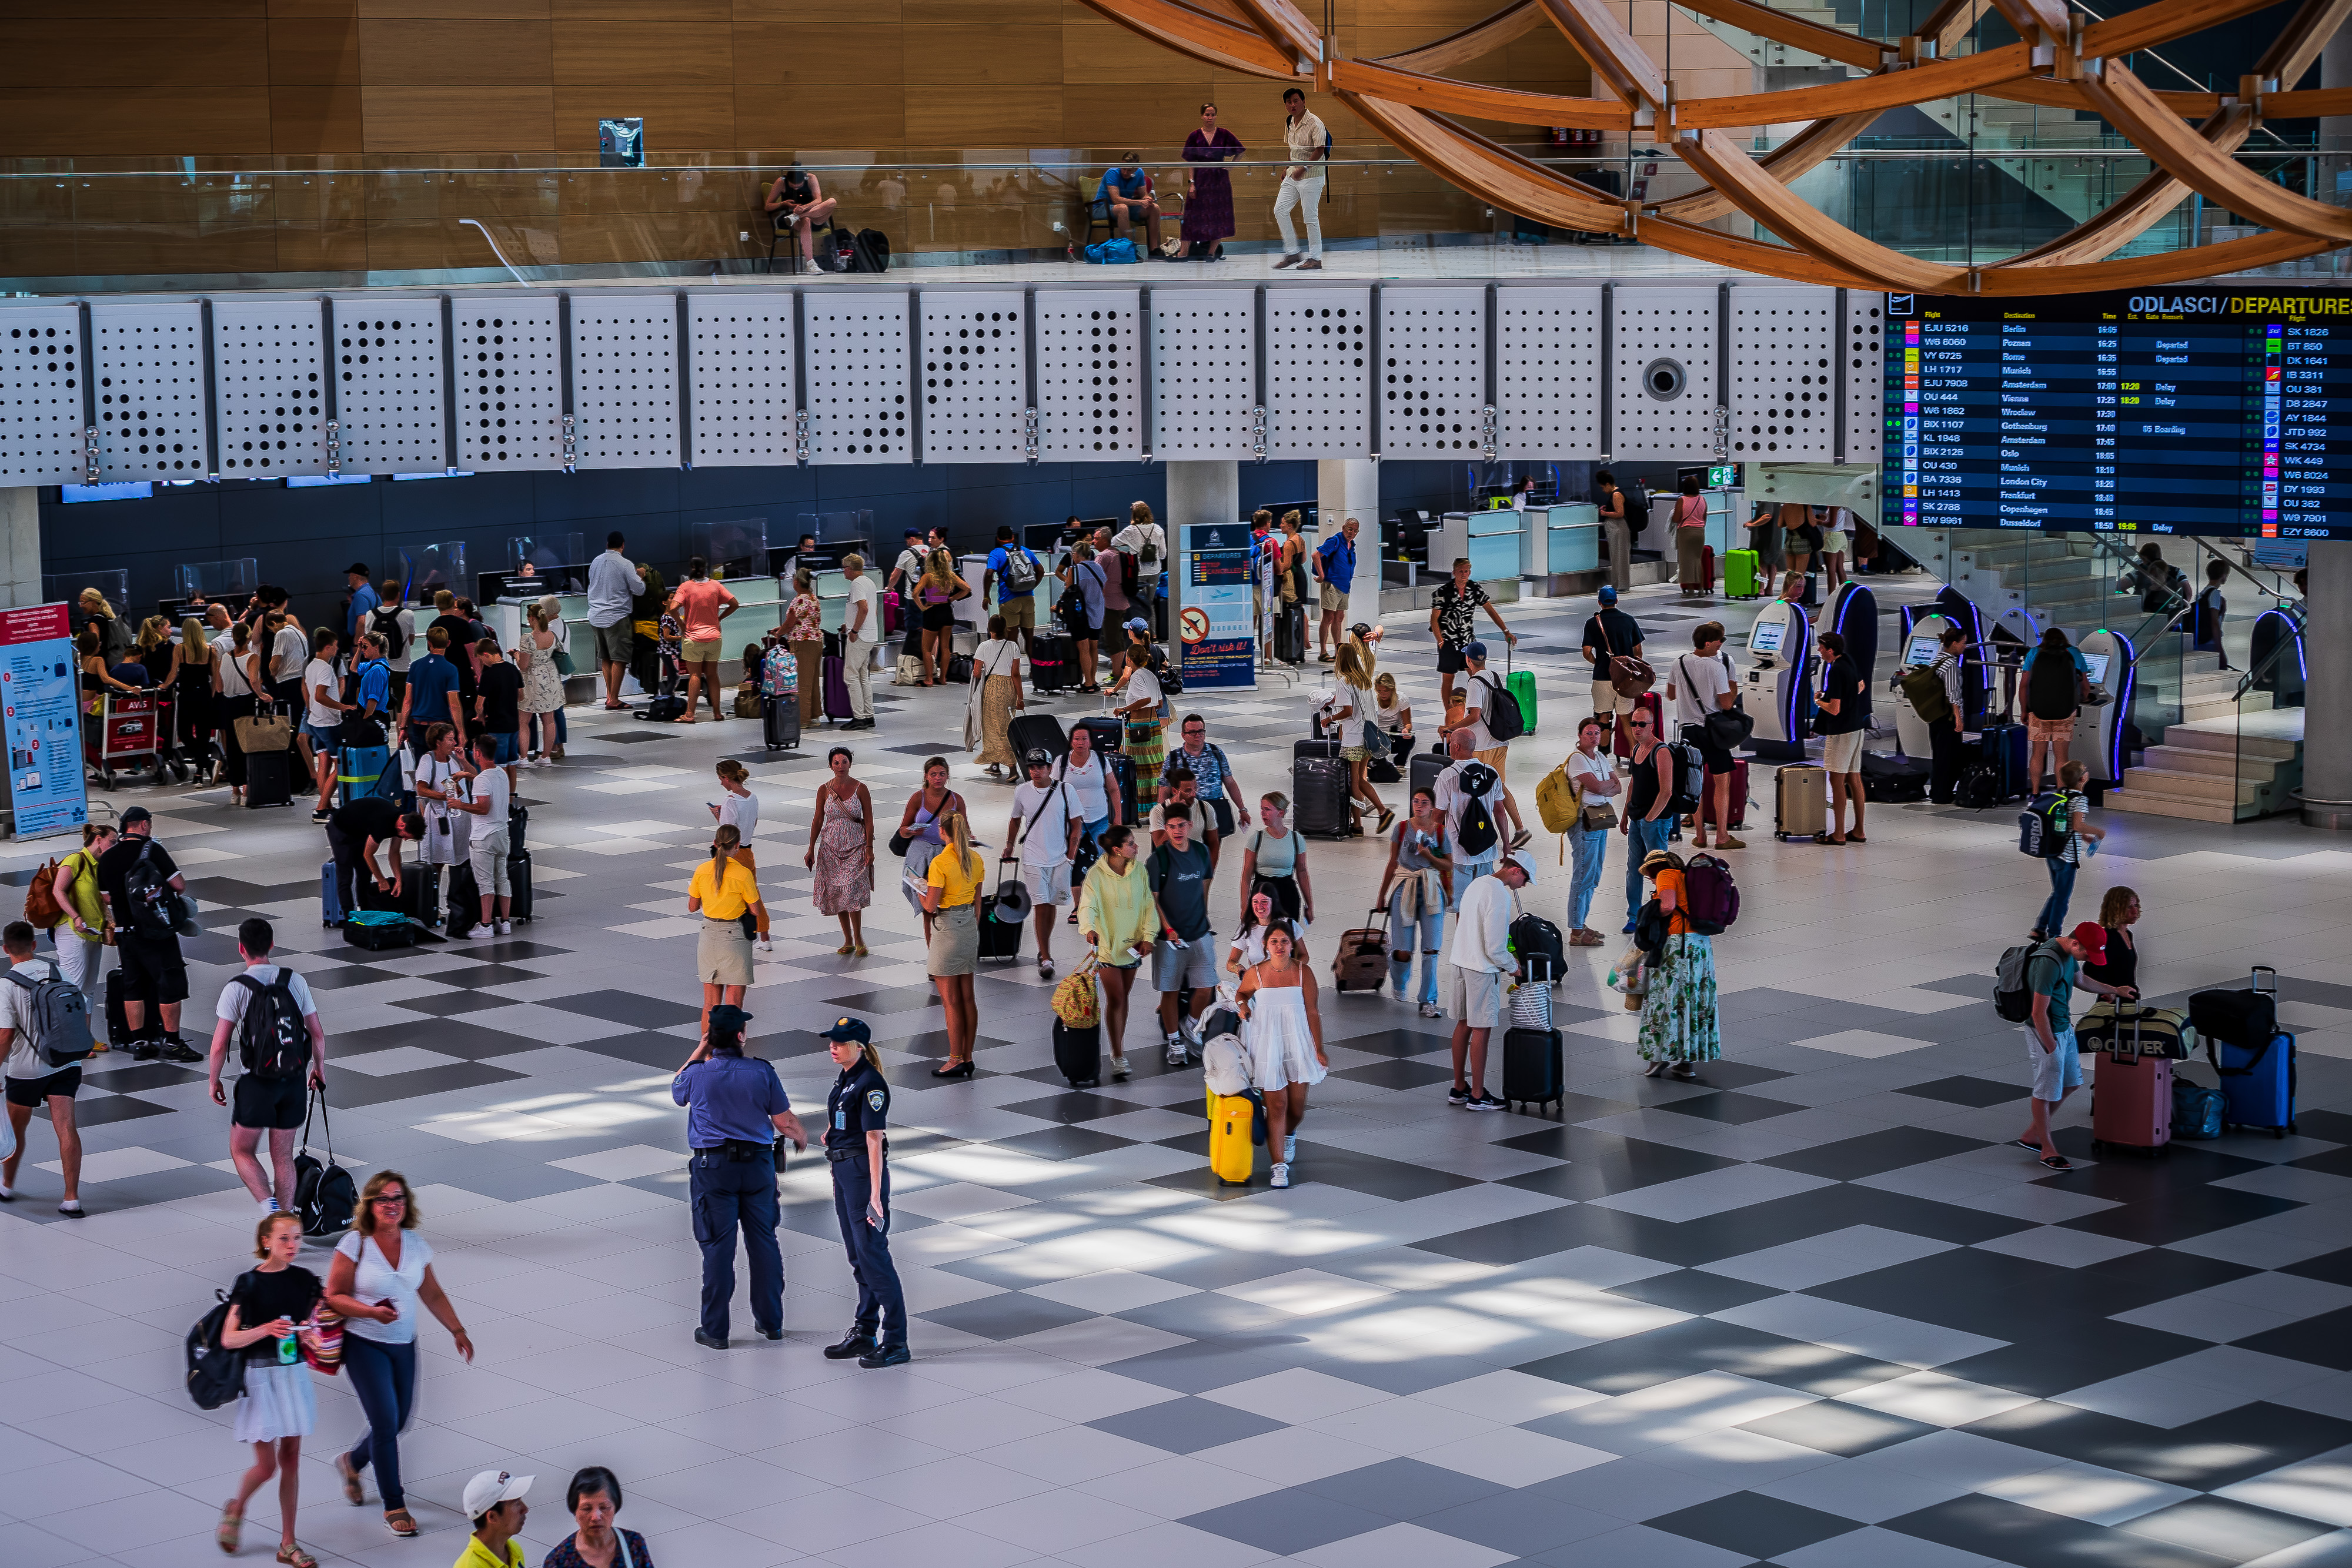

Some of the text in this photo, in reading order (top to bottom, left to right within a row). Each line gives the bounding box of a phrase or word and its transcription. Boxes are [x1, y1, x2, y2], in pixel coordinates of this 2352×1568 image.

[2156, 340, 2188, 349] Departed
[2156, 355, 2188, 364] Departed
[2156, 383, 2176, 392] Delay
[2155, 397, 2176, 406] Delay
[2002, 422, 2047, 432] Gothenburg
[2155, 426, 2186, 434] Boarding
[2031, 478, 2047, 487] City
[2000, 505, 2048, 514] Copenhagen
[2153, 524, 2173, 533] Delay
[1190, 641, 1248, 655] Don't risk it!
[2029, 820, 2040, 855] arena
[2104, 1038, 2165, 1054] OLIVER
